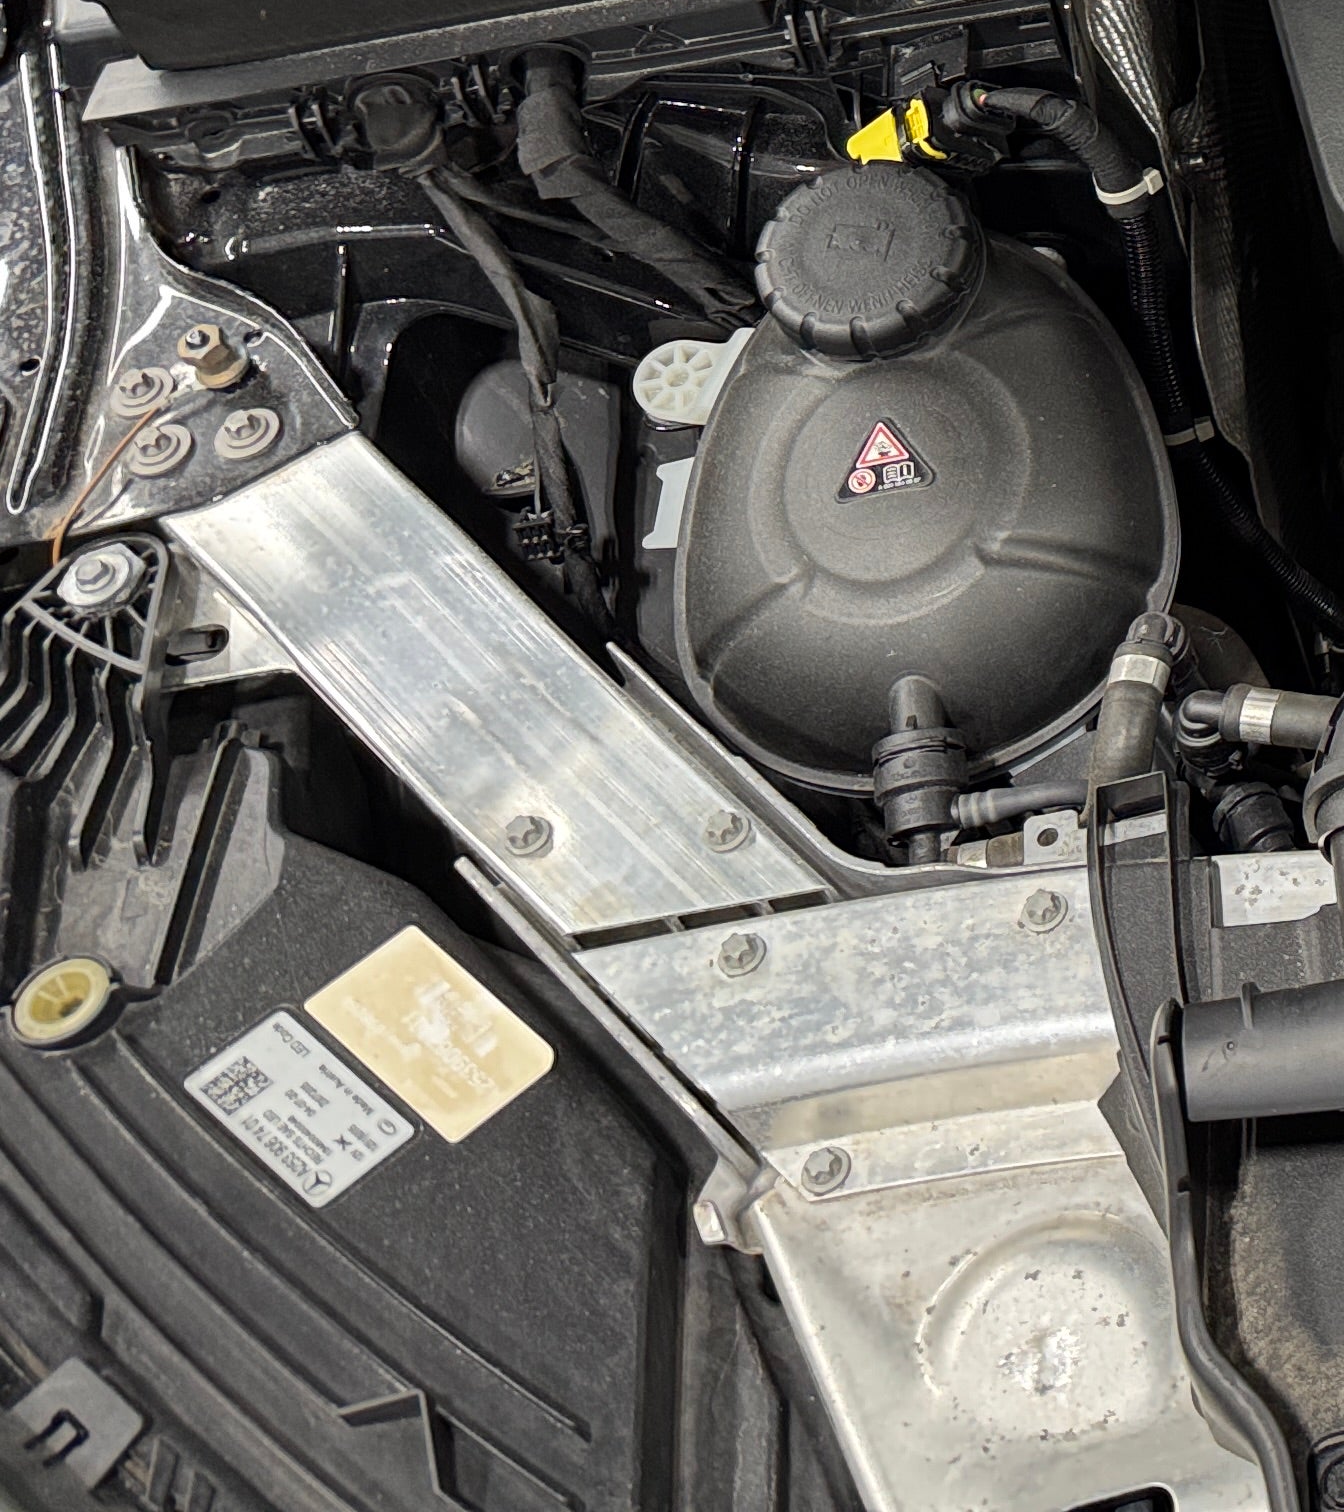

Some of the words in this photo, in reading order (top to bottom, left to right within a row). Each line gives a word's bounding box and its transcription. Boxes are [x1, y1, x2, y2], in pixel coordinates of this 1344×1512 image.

[846, 174, 890, 190] OPEN
[270, 1021, 294, 1043] Code
[289, 1038, 310, 1059] LED
[316, 1063, 345, 1090] Austria
[349, 1093, 374, 1116] Made
[251, 1123, 272, 1143] 74
[263, 1134, 289, 1158] 906
